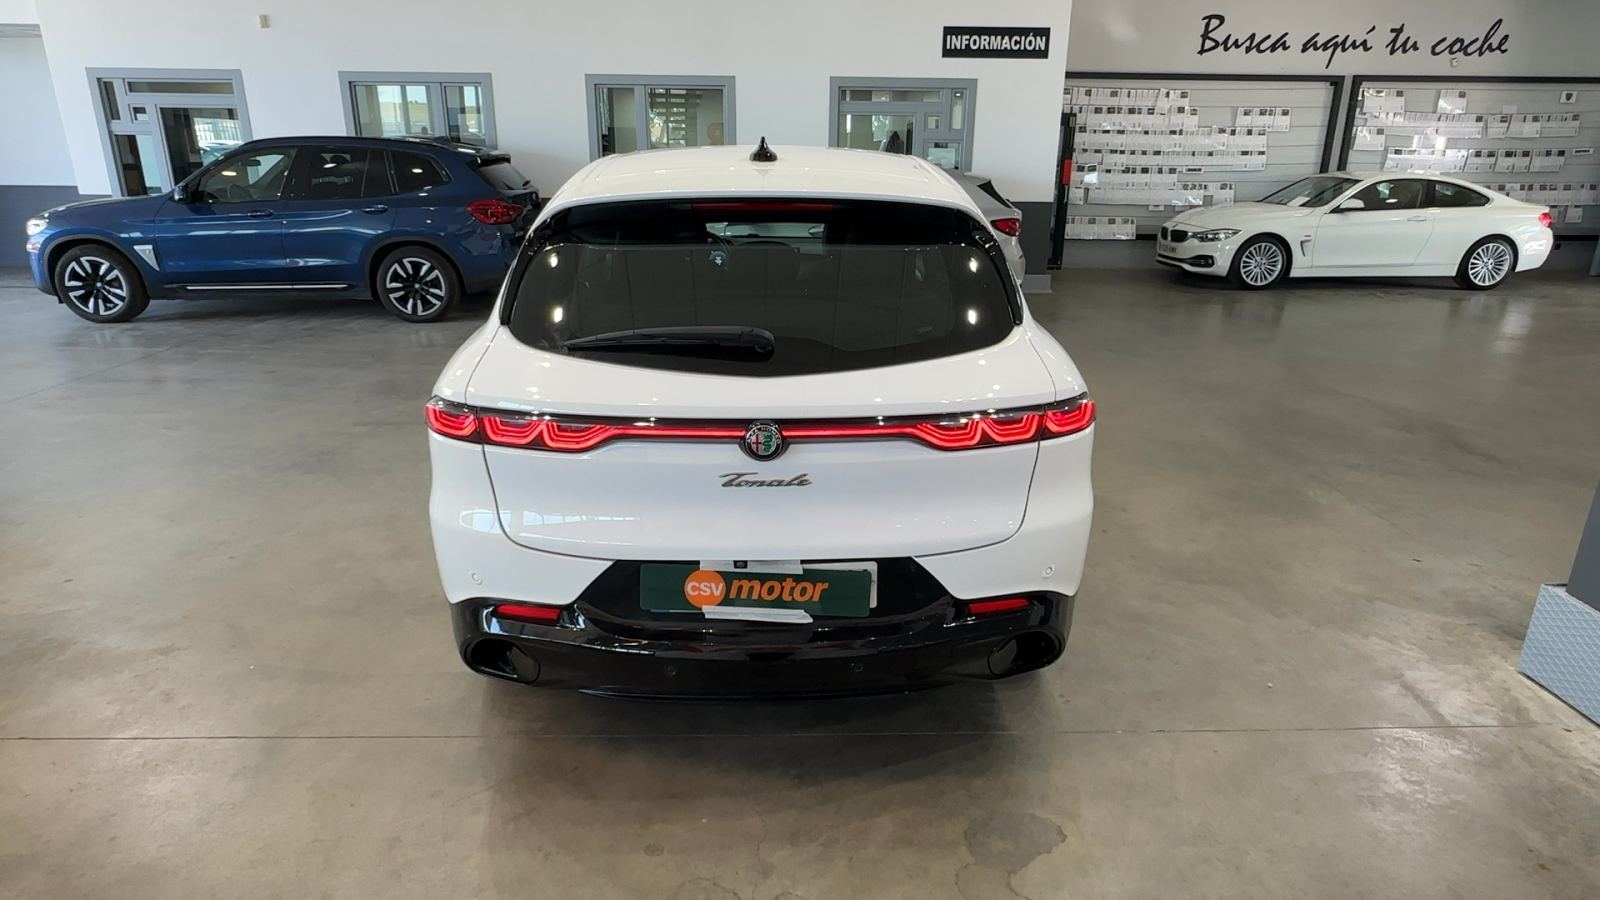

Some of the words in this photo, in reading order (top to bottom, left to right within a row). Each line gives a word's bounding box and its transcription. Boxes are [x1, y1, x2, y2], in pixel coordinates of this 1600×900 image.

[946, 32, 1046, 51] INFORMACIÓN
[1197, 14, 1291, 56] Busca
[1300, 25, 1376, 70] aquí
[1386, 23, 1420, 56] tu
[1430, 18, 1509, 57] coche
[718, 472, 813, 488] Tonale
[686, 582, 724, 597] CSV
[729, 577, 829, 602] motor
